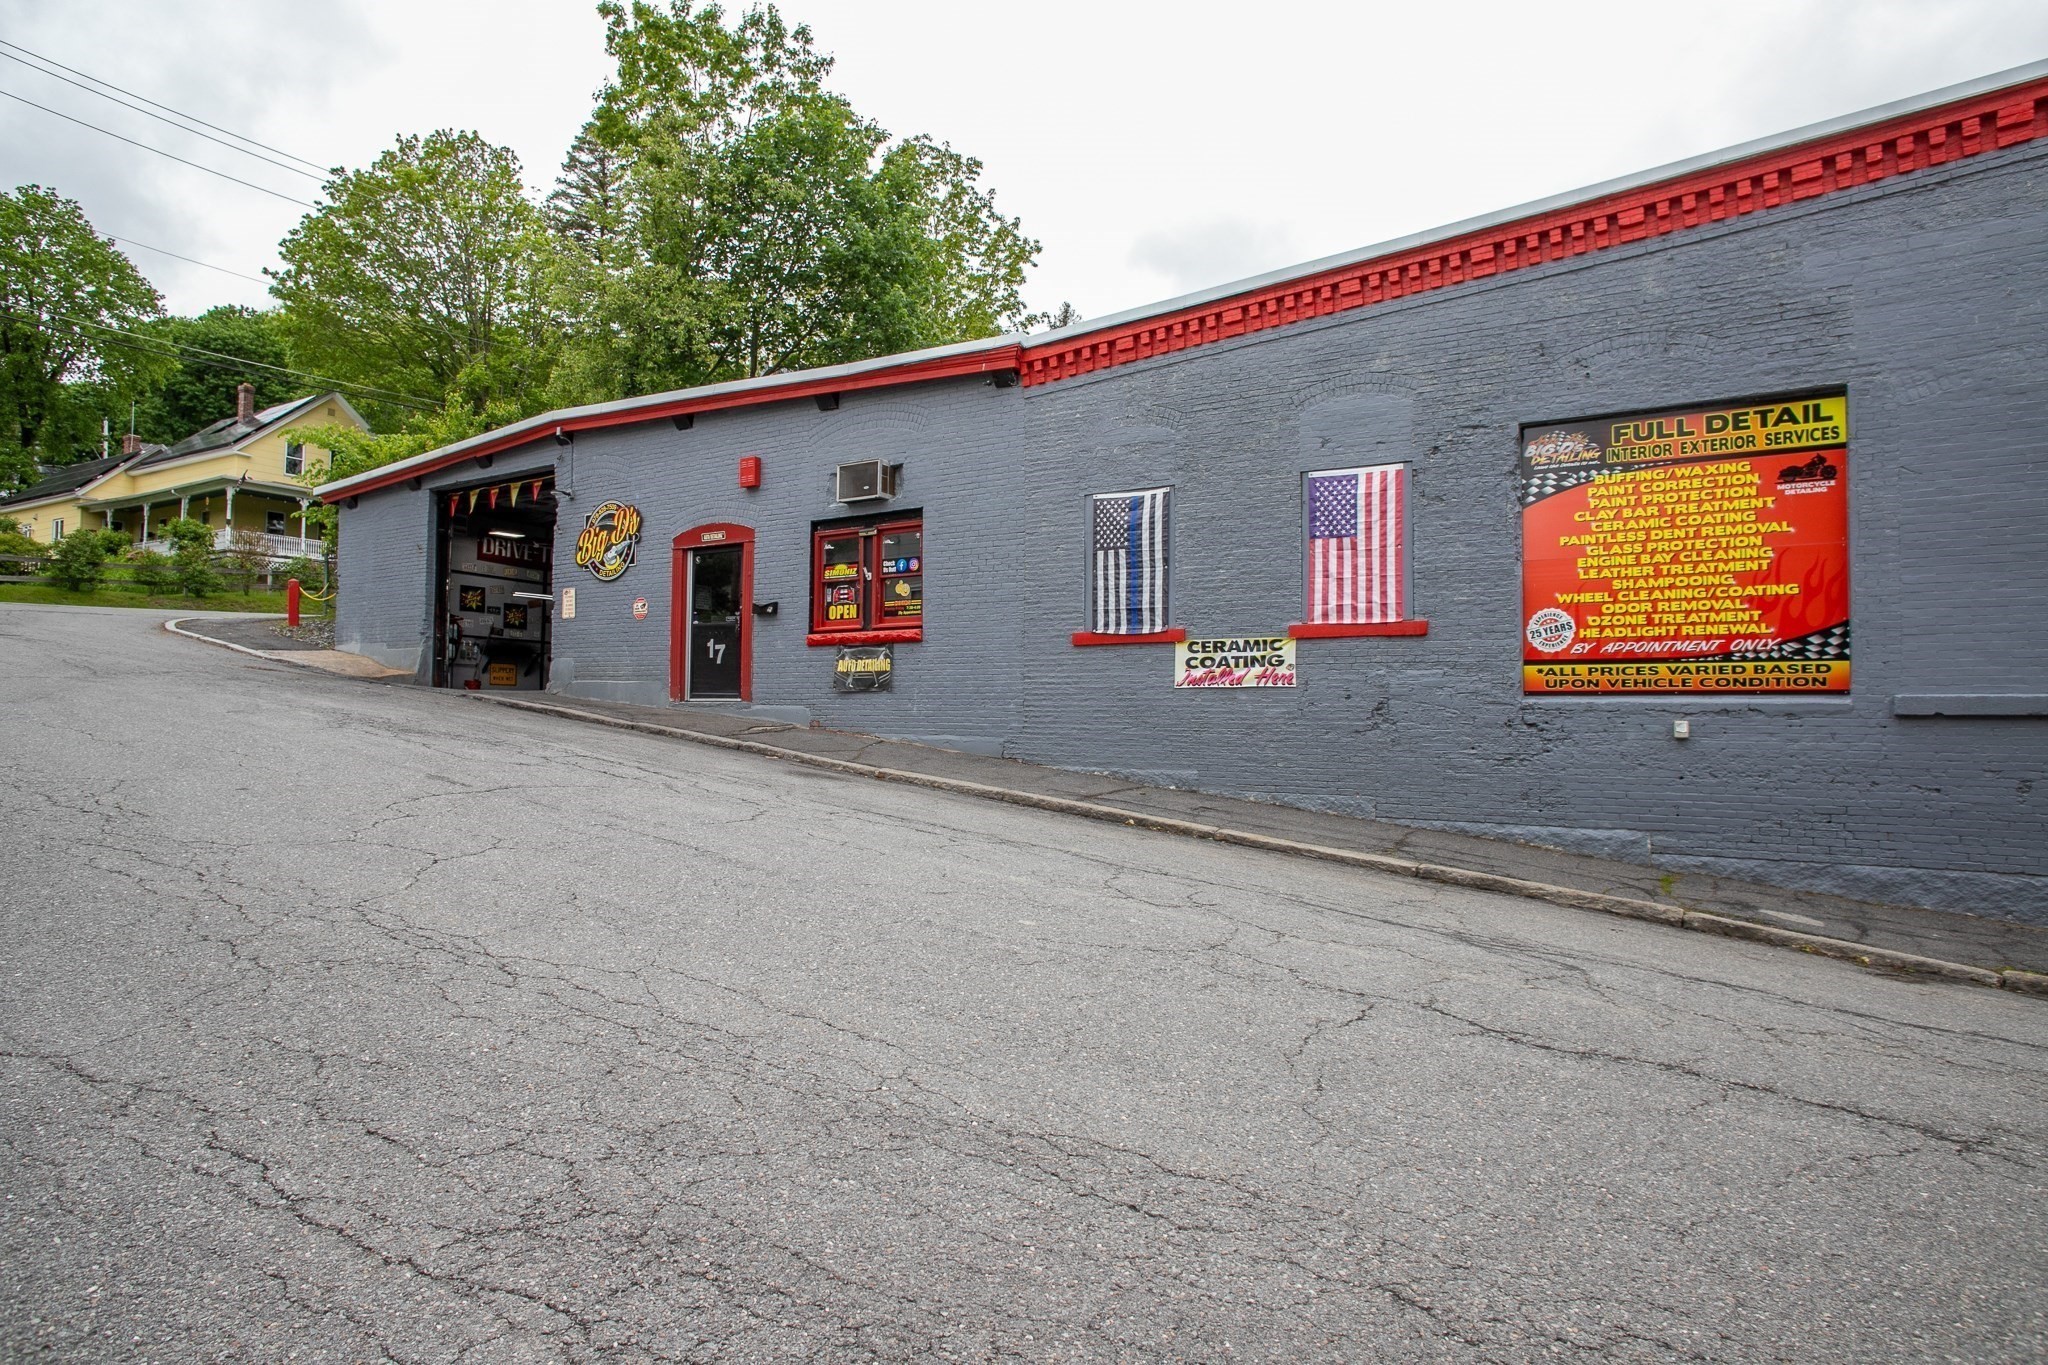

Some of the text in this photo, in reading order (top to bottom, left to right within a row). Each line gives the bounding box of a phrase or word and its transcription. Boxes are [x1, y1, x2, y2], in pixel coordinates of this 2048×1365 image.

[1612, 402, 1834, 446] FULL DETAIL
[1525, 443, 1556, 457] BIG
[1606, 425, 1841, 463] INTERIOR EXTERIOR SERVICES
[1530, 448, 1602, 466] DETAILING
[1594, 461, 1752, 485] BUFFING/WAXING
[1587, 473, 1760, 498] PAINT CORRECTION
[1777, 479, 1837, 491] MOTORCYCLE
[1784, 486, 1829, 496] DETAILING
[1589, 485, 1758, 509] PAINT PROTECTION
[1573, 496, 1776, 522] CLAY BAR TREATMENT
[1591, 510, 1757, 532] CERAMIC COATING
[576, 506, 640, 565] Big D's
[1559, 521, 1793, 546] PAINTLESS DENT REMOVAL
[1586, 535, 1763, 556] GLASS PROTECTION
[1577, 547, 1773, 568] ENGINE BAY CLEANING
[599, 561, 625, 577] DETAILING
[824, 567, 858, 578] SIMONIZ
[1578, 559, 1772, 579] LEATHER TREATMENT
[1612, 574, 1734, 590] SHAMPOOING
[1557, 583, 1801, 604] WHEEL CLEANING/COATING
[828, 604, 857, 620] OPEN
[1601, 599, 1748, 614] ODOR REMOVAL
[1587, 610, 1762, 626] OZONE TREATMENT
[1529, 621, 1573, 639] 25 YEARS
[1579, 623, 1773, 638] HEADLIGHT RENEWAL
[706, 638, 726, 664] 17
[1187, 639, 1284, 654] CERAMIC
[1570, 638, 1783, 654] BY APPOINTMENT ONLY
[837, 658, 891, 672] AUTO DETAILING
[1185, 654, 1286, 669] COATING
[1587, 665, 1659, 677] PRICES
[1666, 664, 1747, 676] VARIED
[1753, 663, 1832, 676] BASED
[1176, 665, 1295, 687] Installed Here
[1544, 676, 1827, 689] UPON VEHICLE CONDITION
